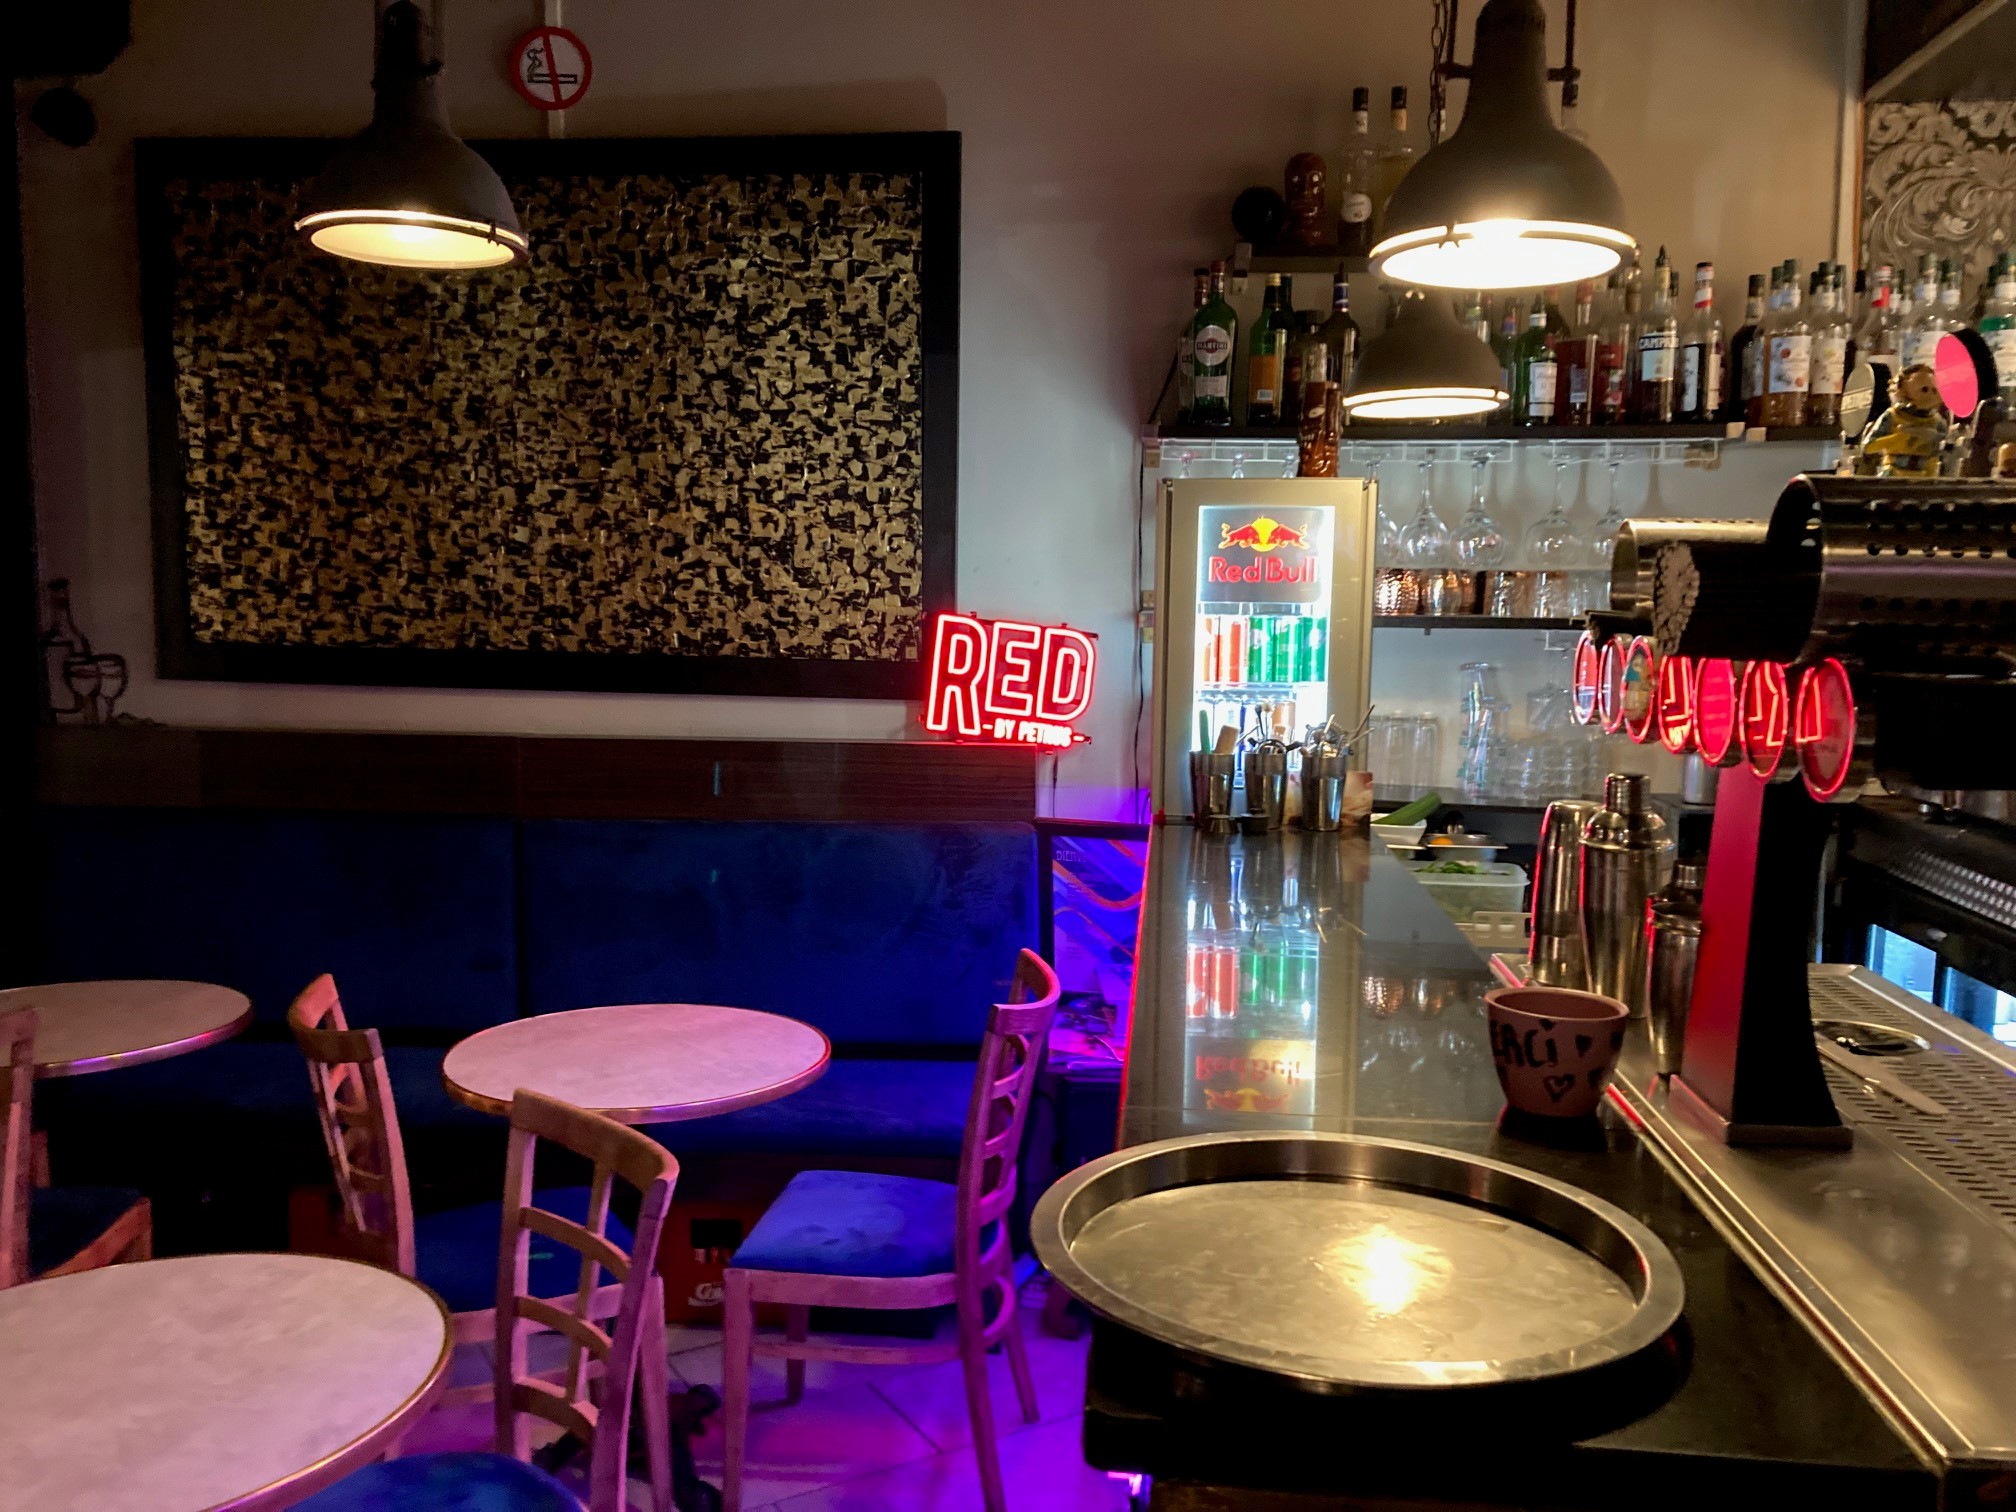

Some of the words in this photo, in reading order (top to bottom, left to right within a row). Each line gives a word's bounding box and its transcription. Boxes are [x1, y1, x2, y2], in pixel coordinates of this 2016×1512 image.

[1208, 556, 1262, 583] Red
[1266, 556, 1318, 583] Bull
[926, 614, 1096, 735] RED
